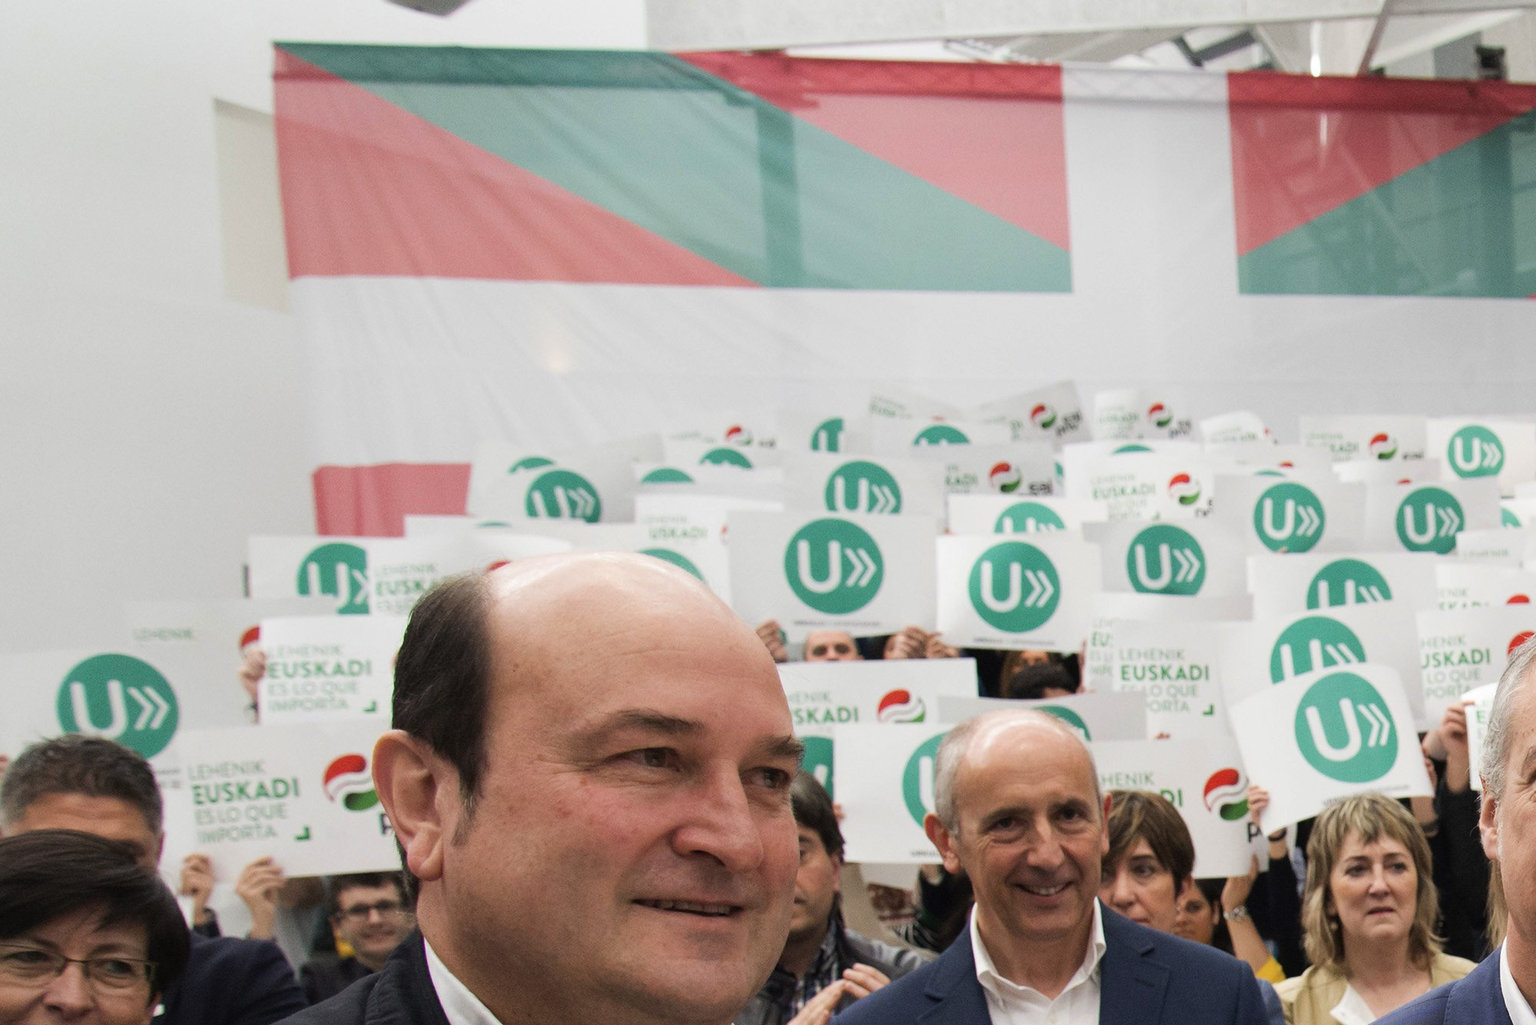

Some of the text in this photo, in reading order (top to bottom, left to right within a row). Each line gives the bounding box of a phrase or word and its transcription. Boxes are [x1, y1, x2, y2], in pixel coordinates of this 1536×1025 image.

[1119, 648, 1185, 661] LEHENIK
[1421, 648, 1491, 669] USKADI
[267, 659, 373, 679] EUSKADI
[1120, 664, 1210, 681] EUSKADI
[793, 706, 858, 725] SKADI
[187, 761, 265, 780] LEHENIK
[1101, 771, 1154, 786] HENIK
[191, 777, 299, 805] EUSKADI
[245, 803, 288, 822] QUE
